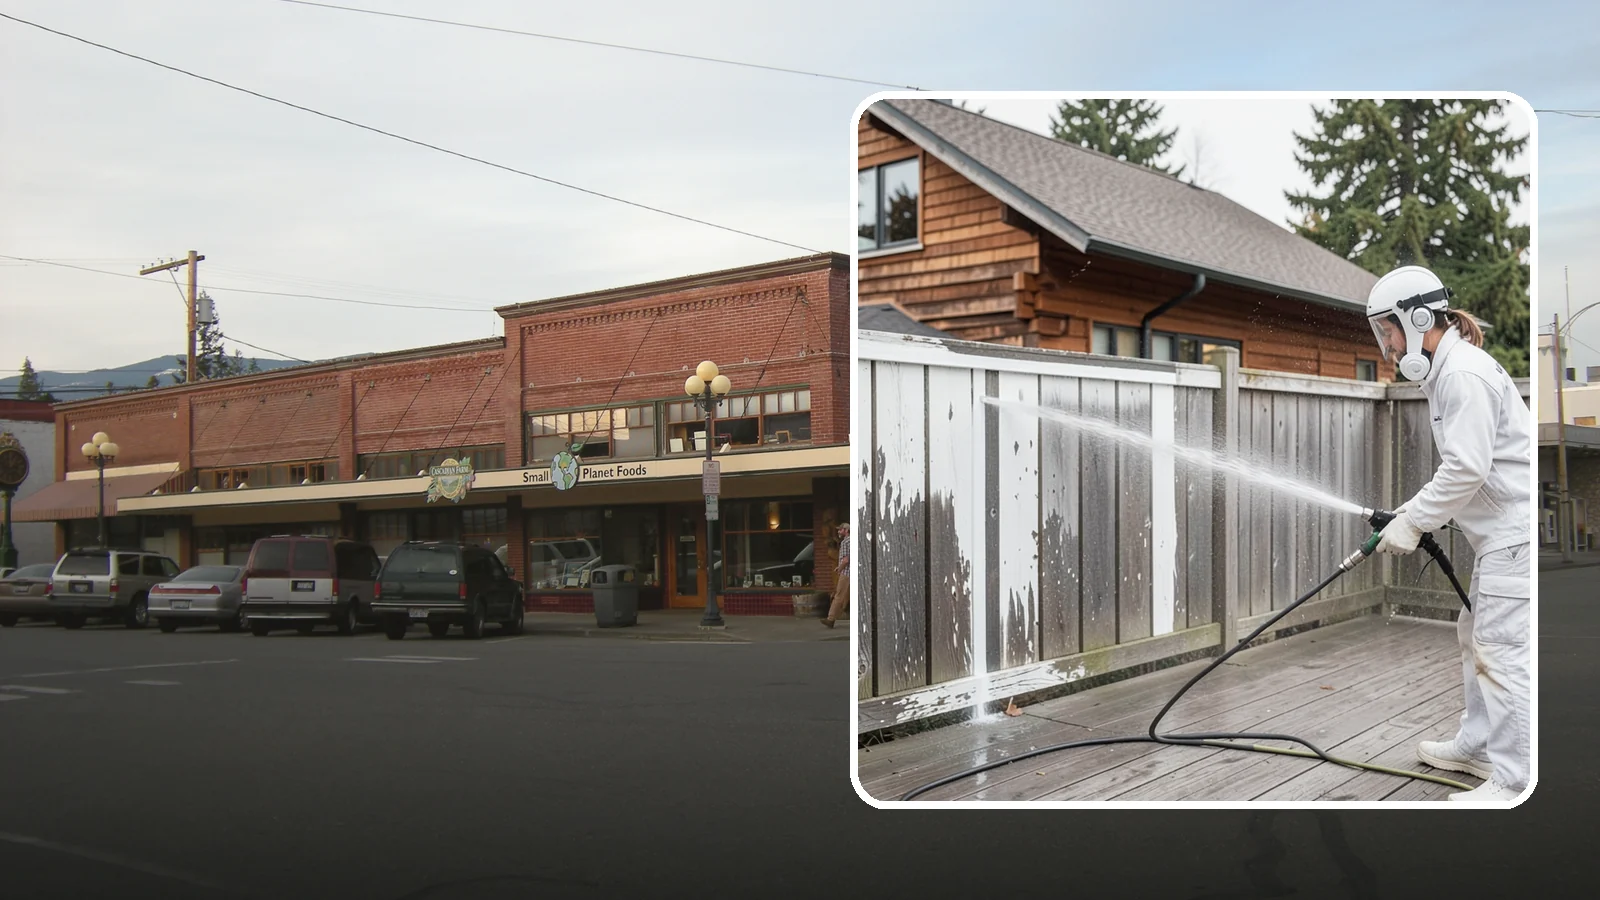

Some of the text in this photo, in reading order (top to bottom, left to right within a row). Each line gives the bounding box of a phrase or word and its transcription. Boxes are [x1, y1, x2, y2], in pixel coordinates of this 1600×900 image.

[523, 464, 647, 483] Small Planet Foods
